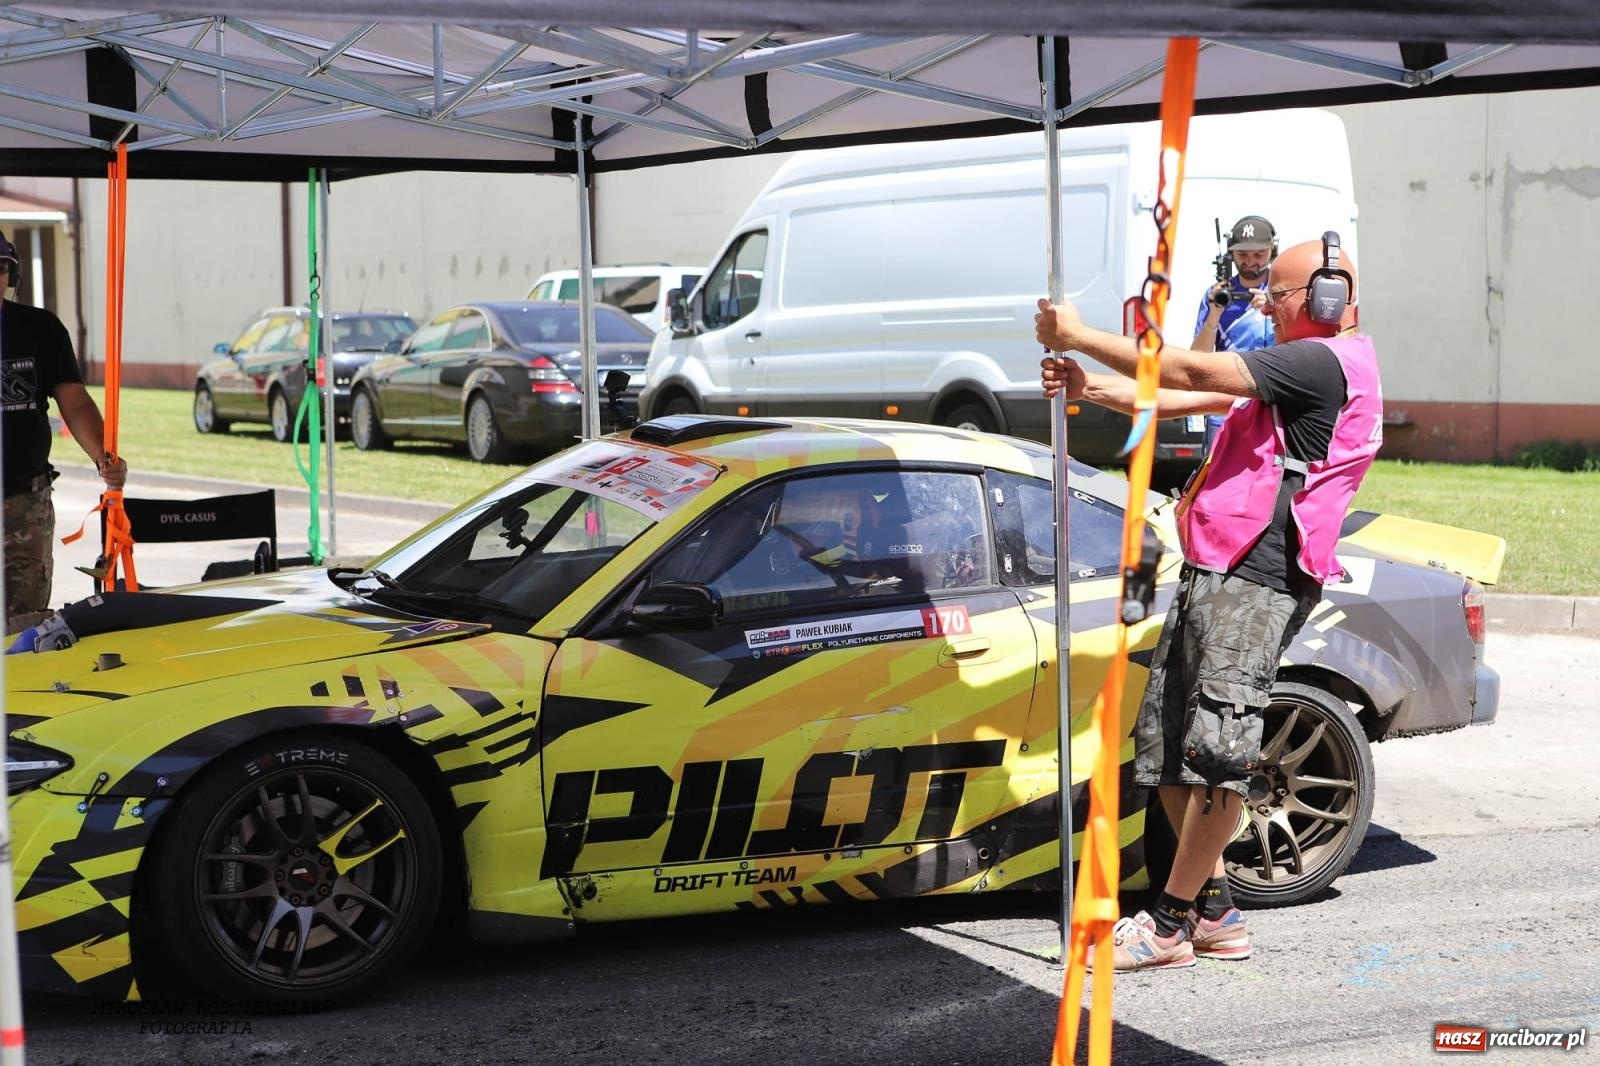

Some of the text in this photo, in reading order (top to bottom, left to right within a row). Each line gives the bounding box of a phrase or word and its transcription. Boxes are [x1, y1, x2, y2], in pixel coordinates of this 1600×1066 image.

[161, 512, 217, 524] DYR. CASUS
[889, 544, 923, 554] sparco
[796, 627, 823, 639] PAWEŁ
[823, 622, 853, 635] KUBIAK
[929, 611, 965, 635] 170
[828, 631, 922, 647] POLYURETHANE COMPONENTS
[540, 739, 1007, 880] PILOT
[653, 866, 797, 893] DRIFT TEAM
